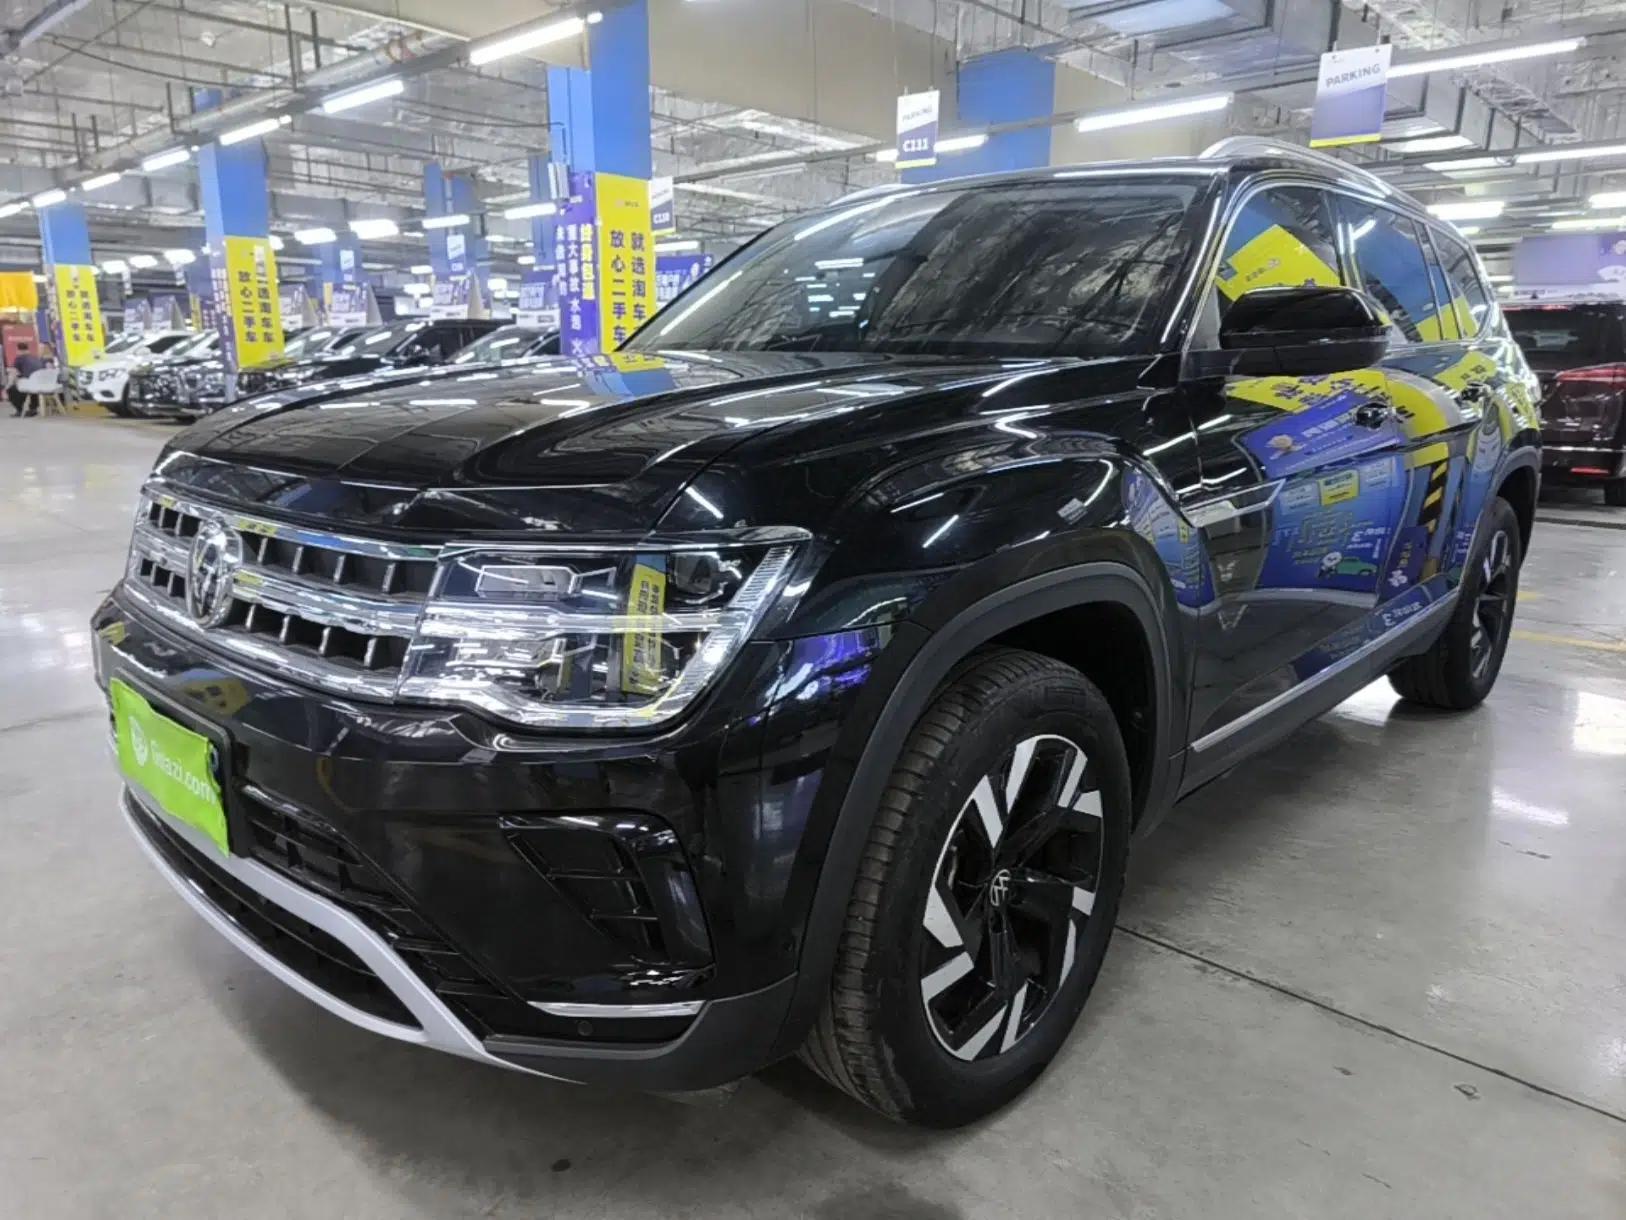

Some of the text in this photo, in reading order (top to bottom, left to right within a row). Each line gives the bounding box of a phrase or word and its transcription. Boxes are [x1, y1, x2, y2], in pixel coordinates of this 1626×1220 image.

[1325, 63, 1381, 88] PARKING
[610, 229, 626, 343] 放心二手车
[631, 232, 647, 331] 就选淘车
